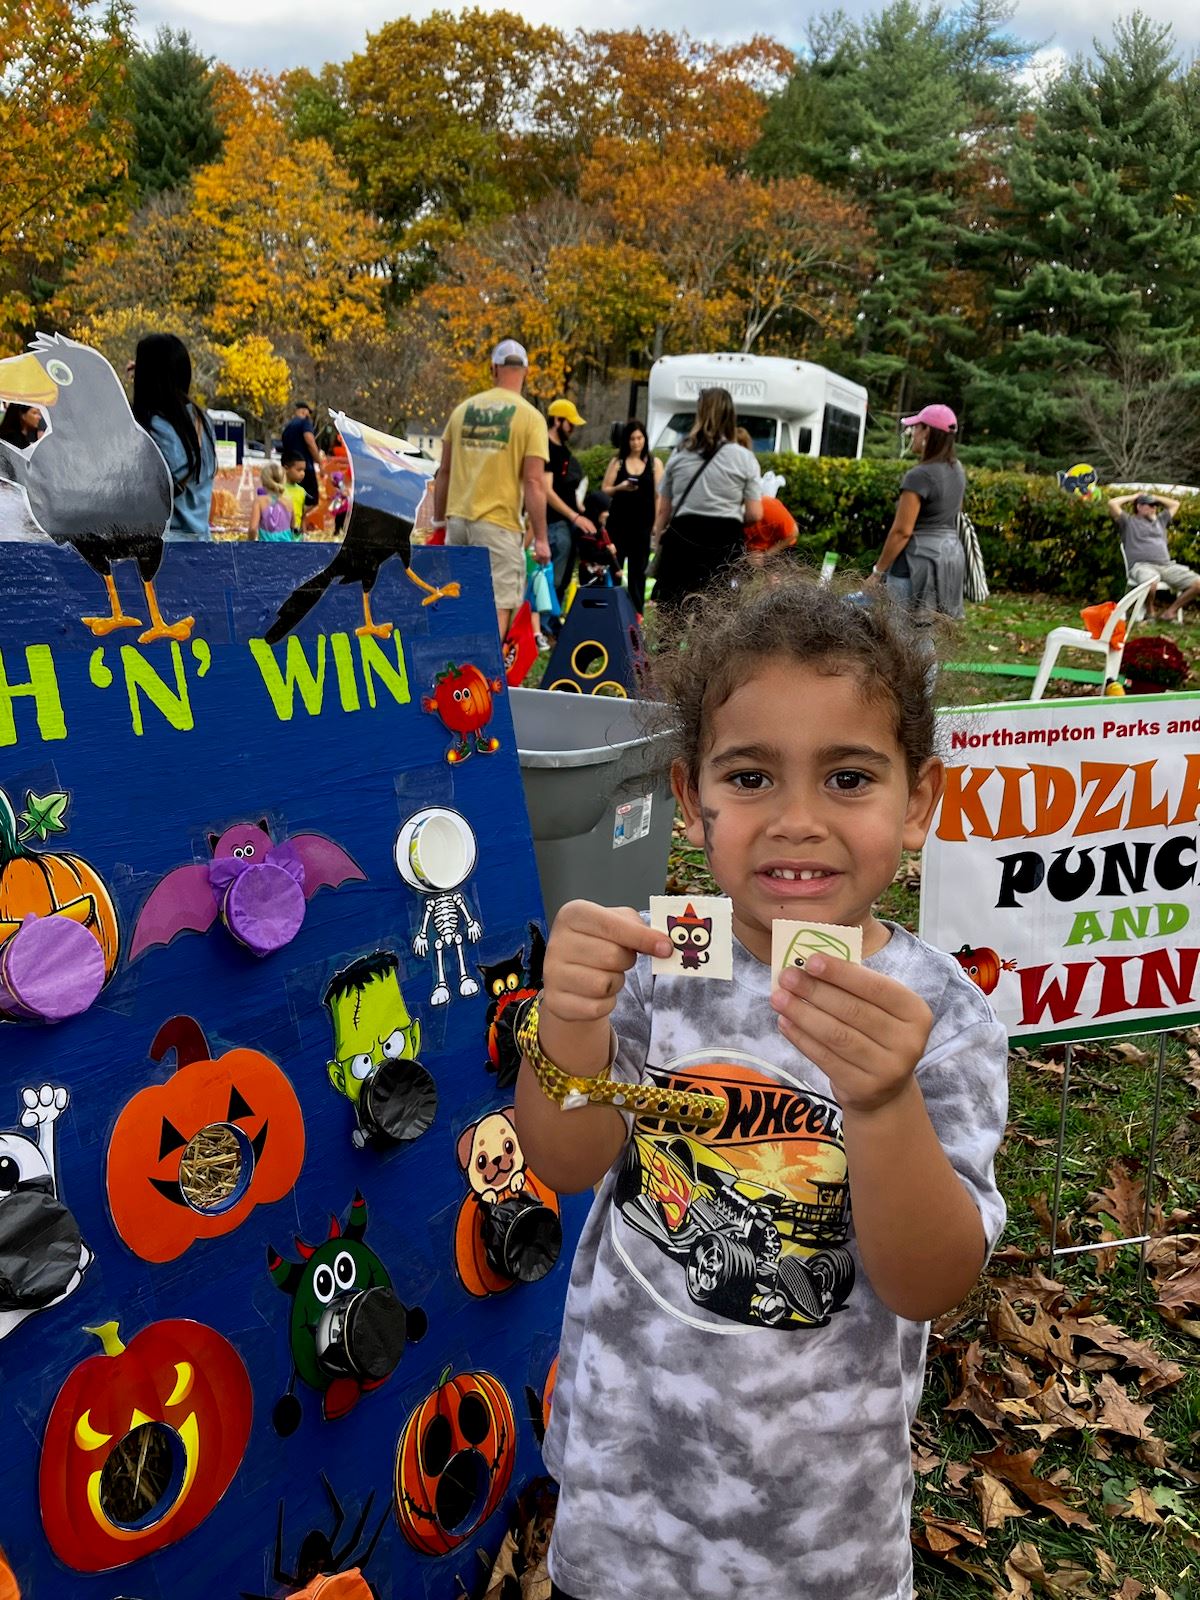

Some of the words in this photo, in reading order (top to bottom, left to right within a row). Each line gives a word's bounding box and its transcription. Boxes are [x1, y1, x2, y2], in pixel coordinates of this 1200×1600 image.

[249, 629, 411, 721] WIN
[951, 725, 1095, 749] Northampton
[1103, 719, 1160, 739] Parks
[995, 833, 1200, 908] PUNC
[1063, 903, 1190, 947] AND
[1016, 947, 1200, 1026] WIN
